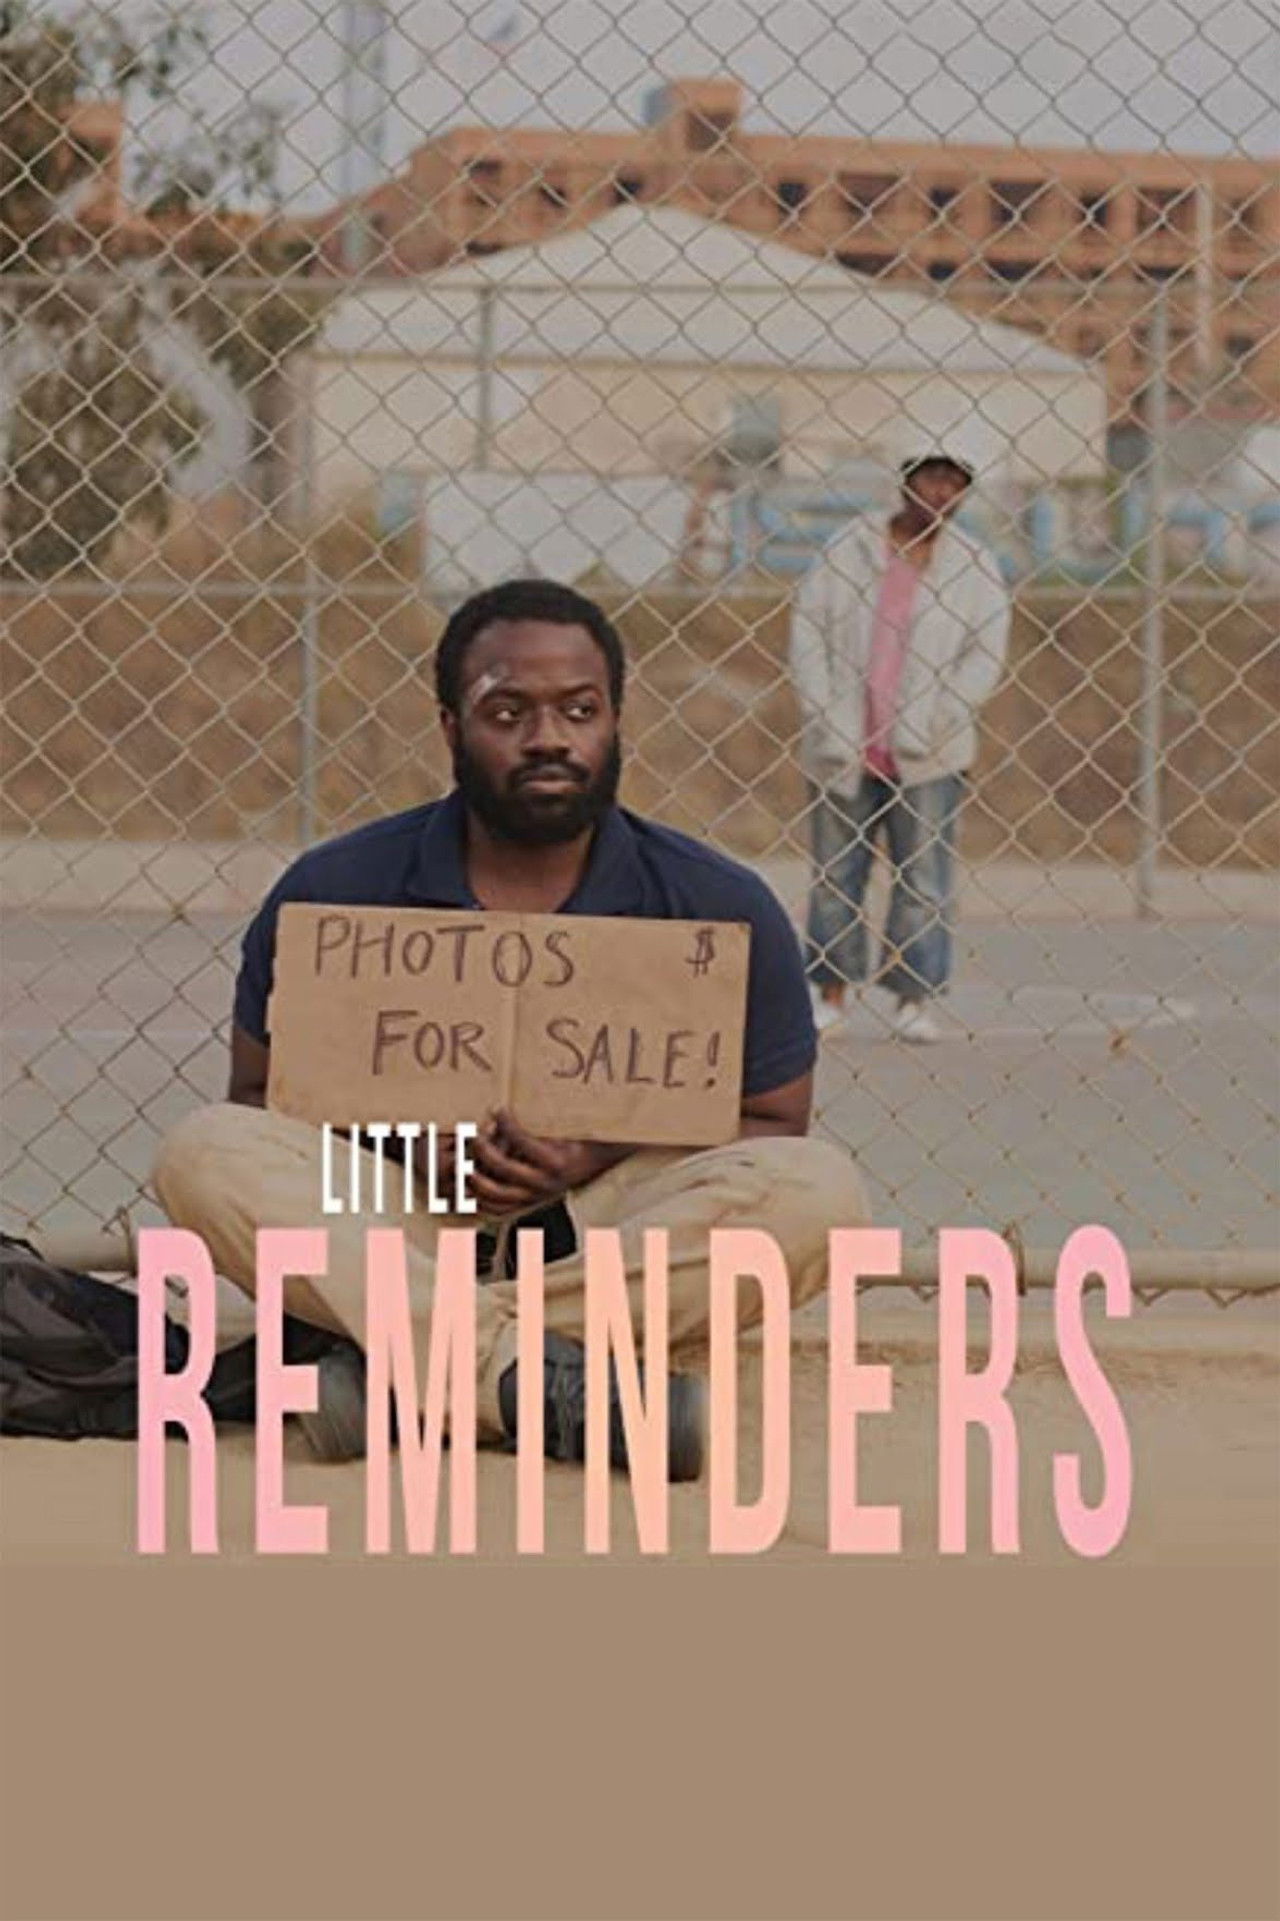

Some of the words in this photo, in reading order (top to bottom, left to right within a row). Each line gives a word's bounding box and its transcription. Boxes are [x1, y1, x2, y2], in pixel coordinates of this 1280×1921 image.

[314, 915, 575, 987] PHOTOS
[685, 926, 716, 978] $
[371, 1010, 493, 1076] FOR
[546, 1018, 721, 1090] SALE!
